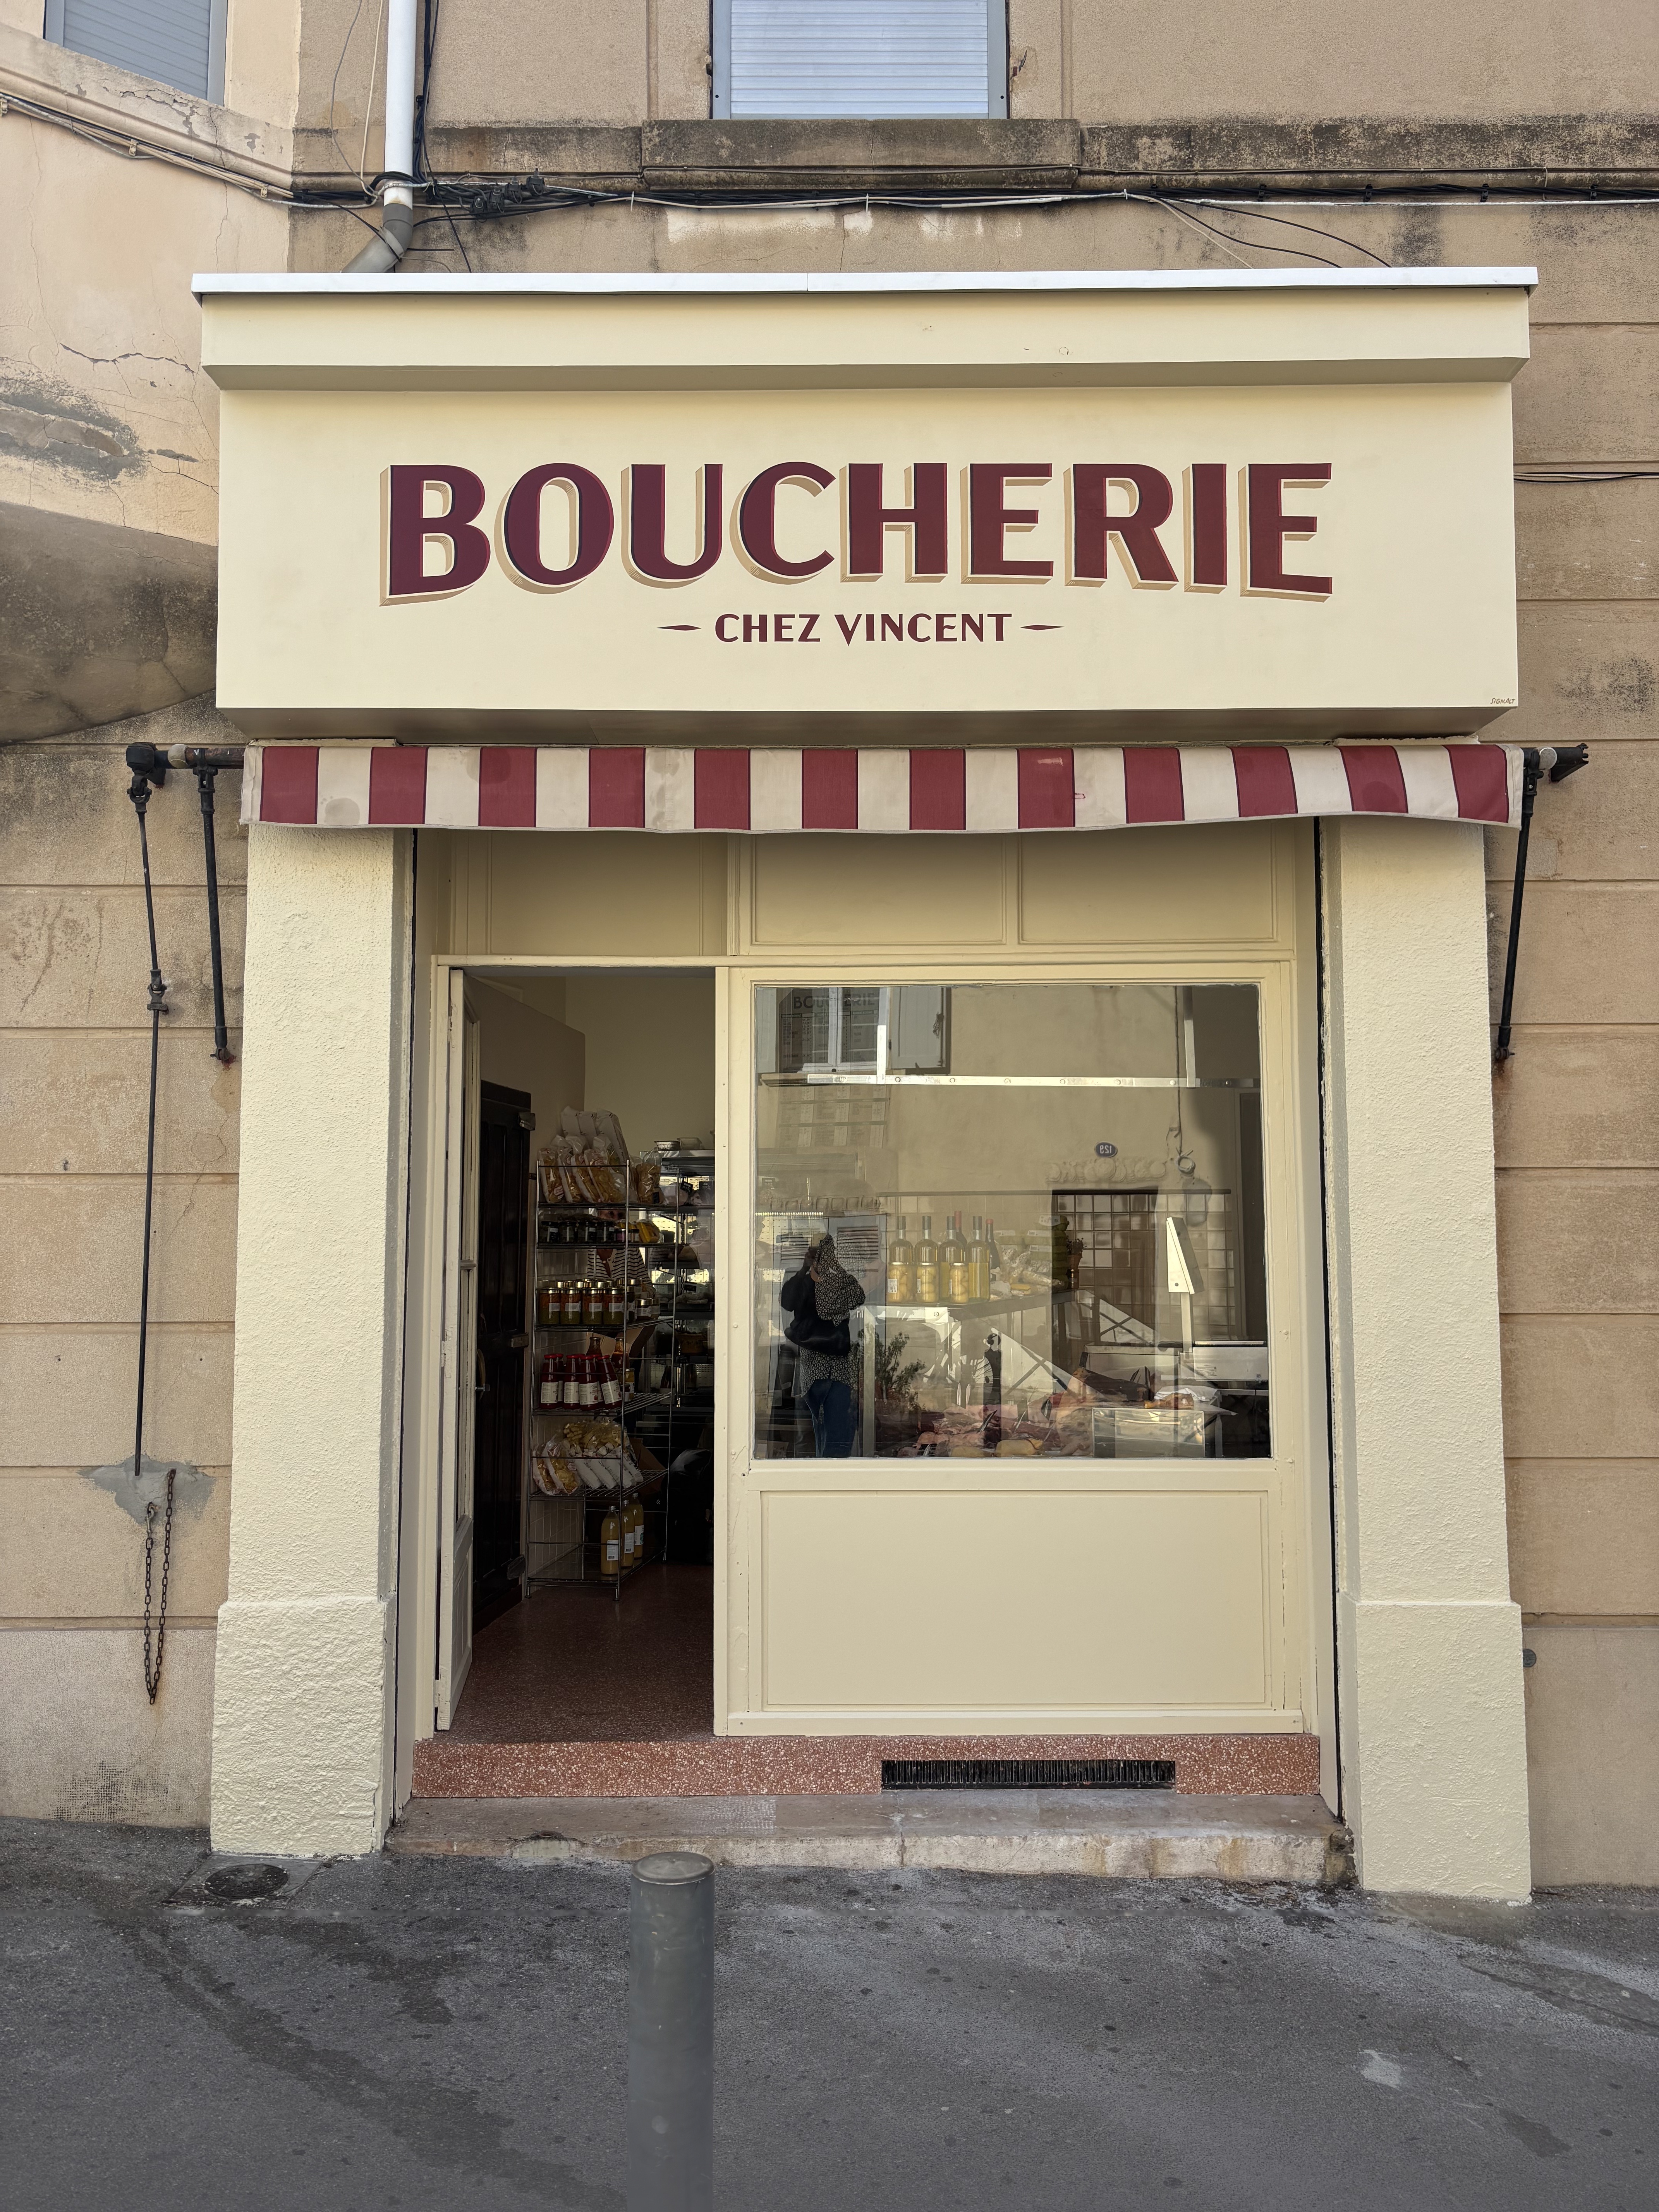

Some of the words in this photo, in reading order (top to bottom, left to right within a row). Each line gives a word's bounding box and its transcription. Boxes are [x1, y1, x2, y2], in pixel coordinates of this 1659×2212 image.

[380, 461, 1333, 606] BOUCHERIE
[715, 614, 820, 642] CHEZ
[834, 613, 1012, 646] VINCENT
